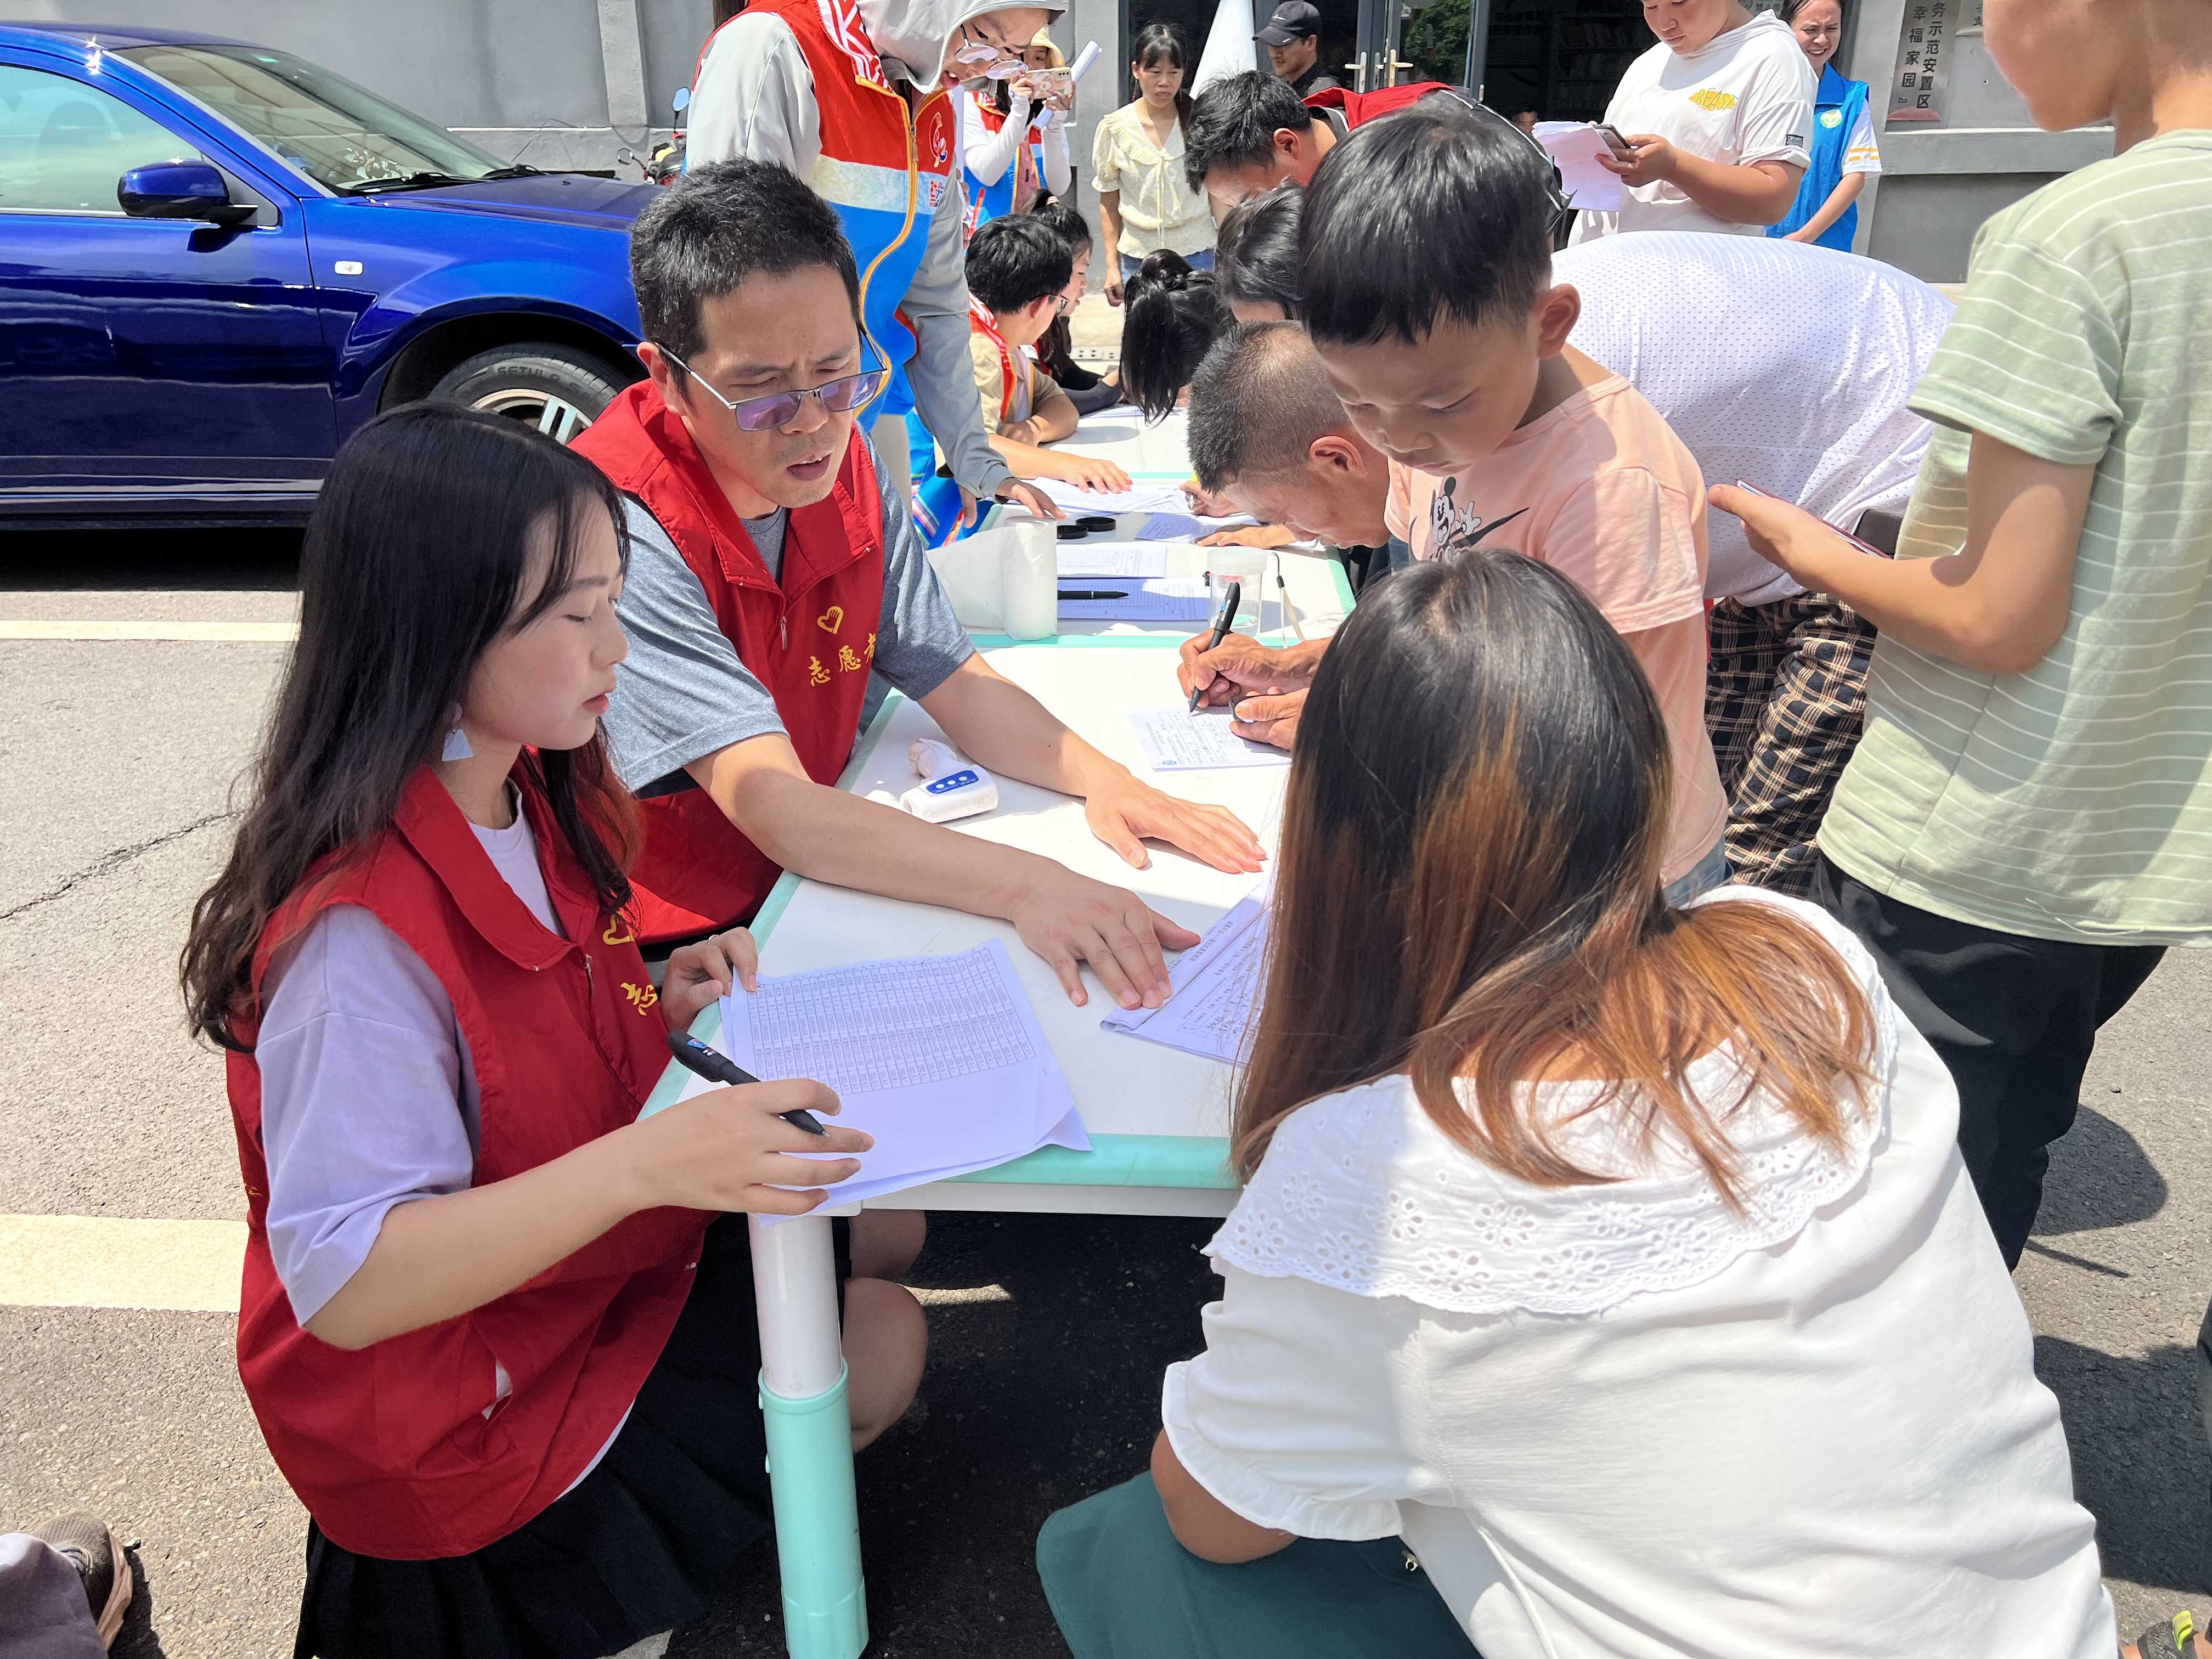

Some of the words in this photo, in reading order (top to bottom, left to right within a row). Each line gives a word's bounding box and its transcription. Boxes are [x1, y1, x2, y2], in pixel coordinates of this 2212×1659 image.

[1917, 3, 1945, 109] 务示范安置区
[1695, 88, 1739, 111] BEAST
